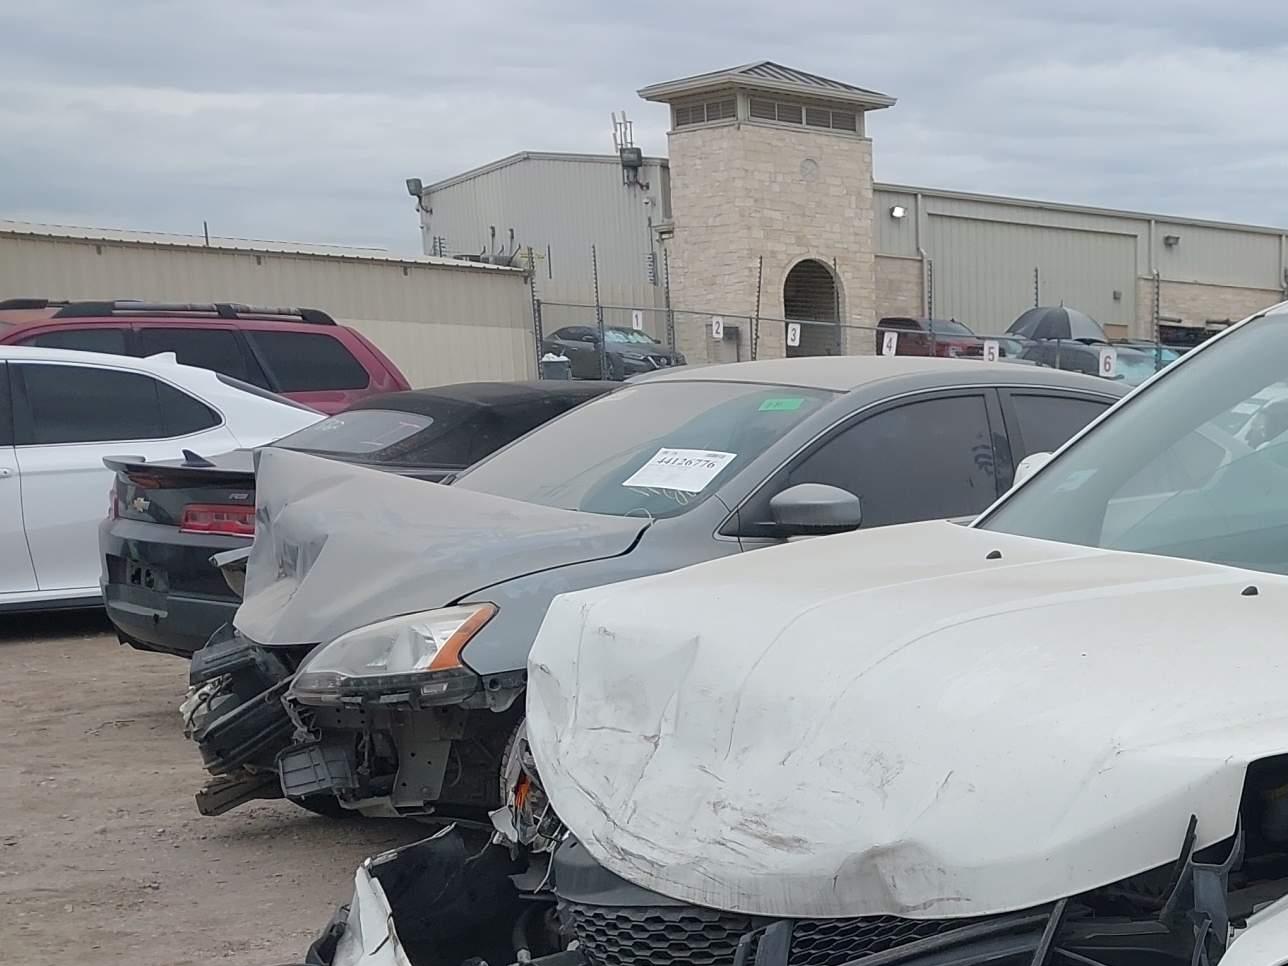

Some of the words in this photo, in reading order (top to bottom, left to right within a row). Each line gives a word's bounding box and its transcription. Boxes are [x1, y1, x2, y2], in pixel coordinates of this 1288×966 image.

[714, 320, 721, 335] 2
[790, 328, 797, 342] 3
[886, 336, 893, 349] 4
[987, 346, 995, 362] 5
[1103, 356, 1112, 372] 6
[656, 456, 716, 469] 44126776
